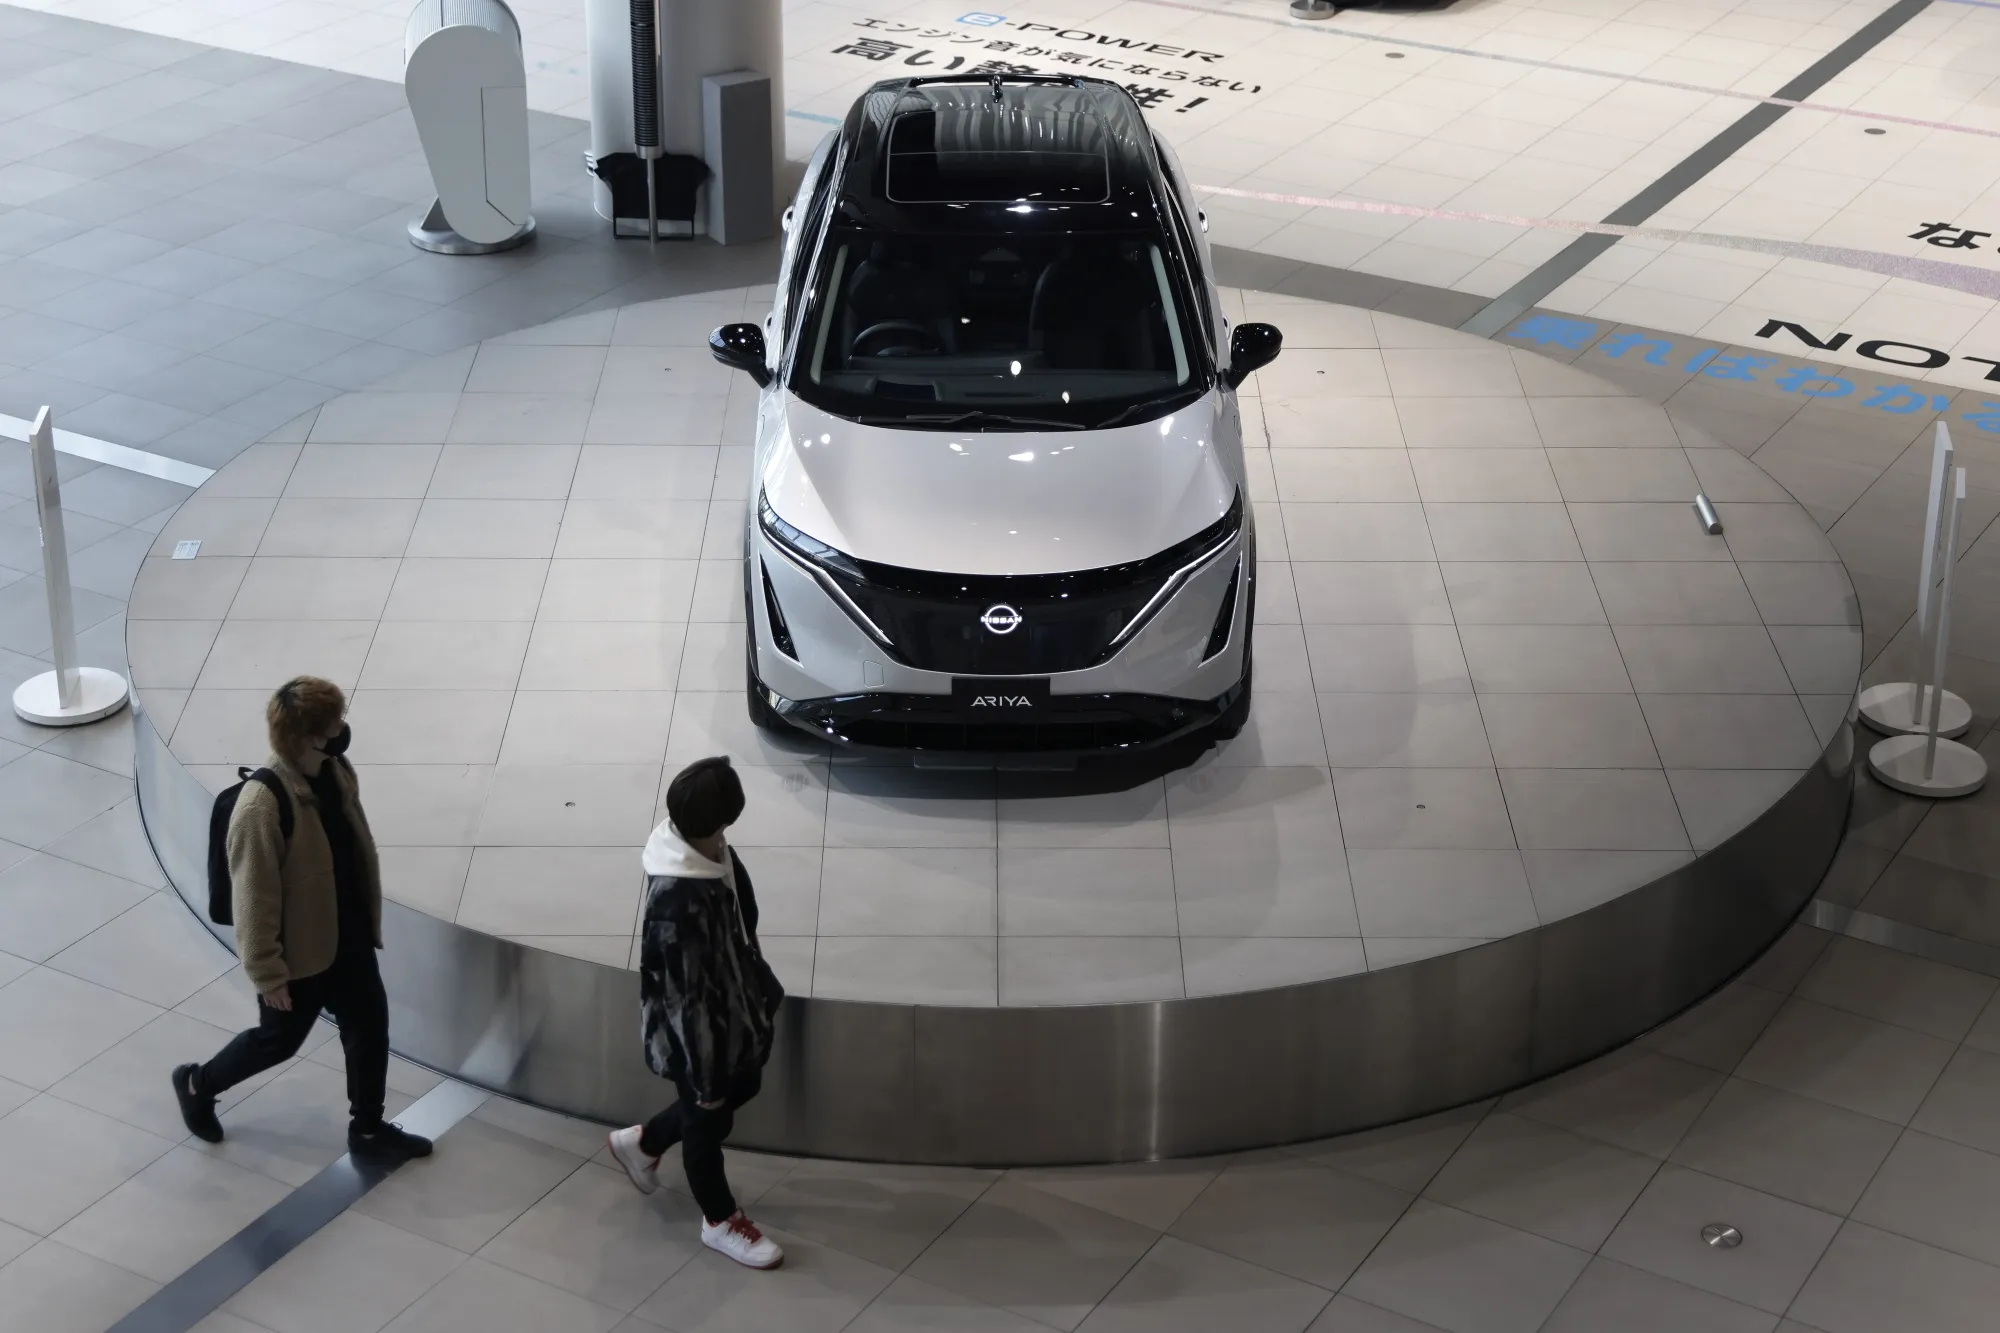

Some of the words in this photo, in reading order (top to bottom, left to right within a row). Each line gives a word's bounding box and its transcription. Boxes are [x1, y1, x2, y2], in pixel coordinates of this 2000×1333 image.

[852, 18, 1261, 94] エンジン音が気にならない
[981, 616, 1022, 624] NISSAN
[971, 696, 1032, 706] ARIYA
